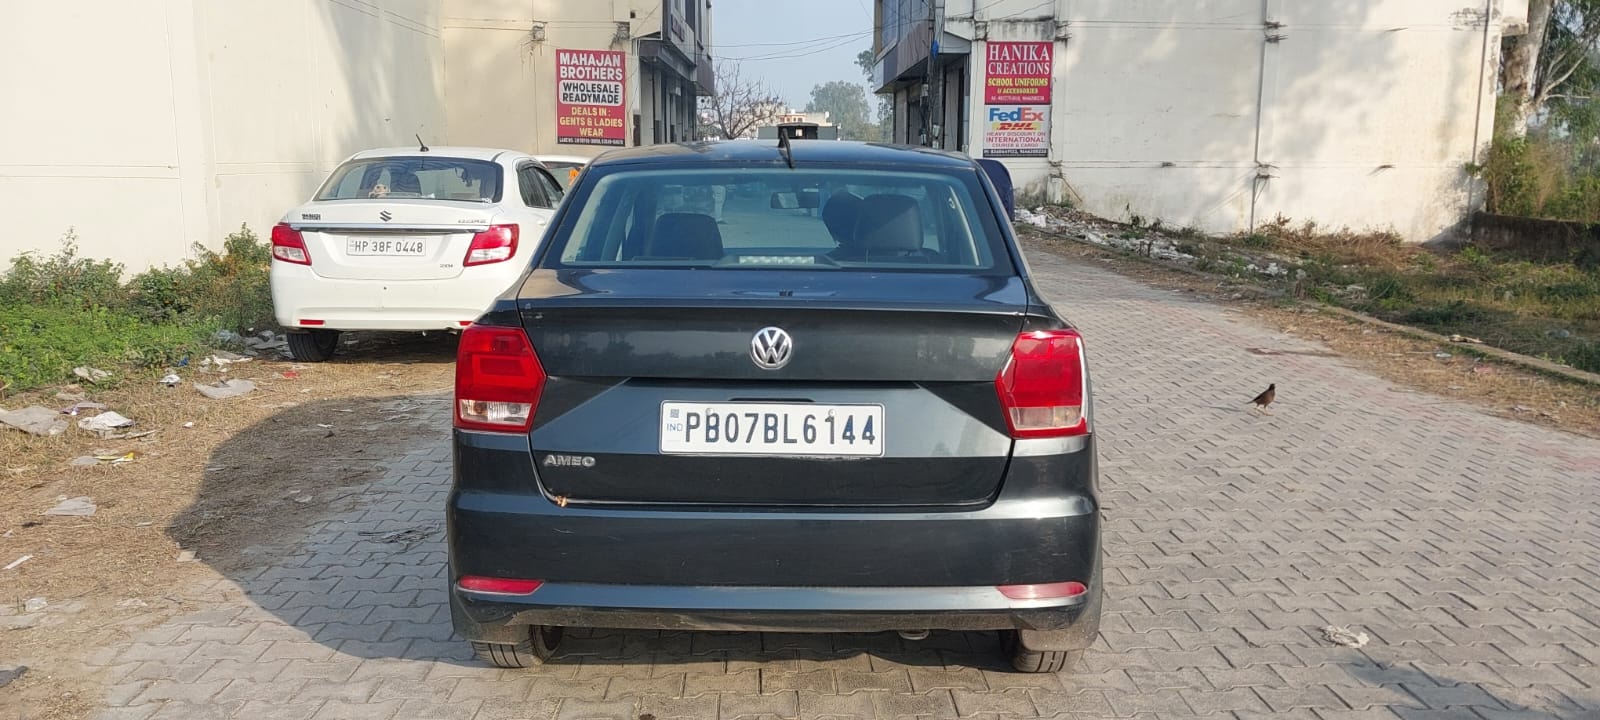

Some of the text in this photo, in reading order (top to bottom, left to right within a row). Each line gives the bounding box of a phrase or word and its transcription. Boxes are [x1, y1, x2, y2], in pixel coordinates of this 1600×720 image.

[989, 44, 1050, 61] HANIKA
[559, 52, 621, 67] MAHAJAN
[559, 65, 623, 81] BROTHERS
[988, 62, 1050, 75] CREATIONS
[562, 82, 620, 94] WHOLESALE
[988, 78, 1048, 87] SCHOOL UNIFORMS
[562, 92, 619, 104] READYMADE
[571, 106, 598, 116] DEALS
[989, 107, 1044, 121] FedEx
[559, 116, 623, 128] GENTS & LADIES
[996, 122, 1037, 130] DHL
[579, 127, 604, 137] WEAR
[355, 240, 369, 253] HP
[371, 241, 393, 253] 38F
[395, 241, 424, 253] 0448
[666, 411, 877, 445] IND PB07BL6144
[543, 454, 596, 467] AMEO
